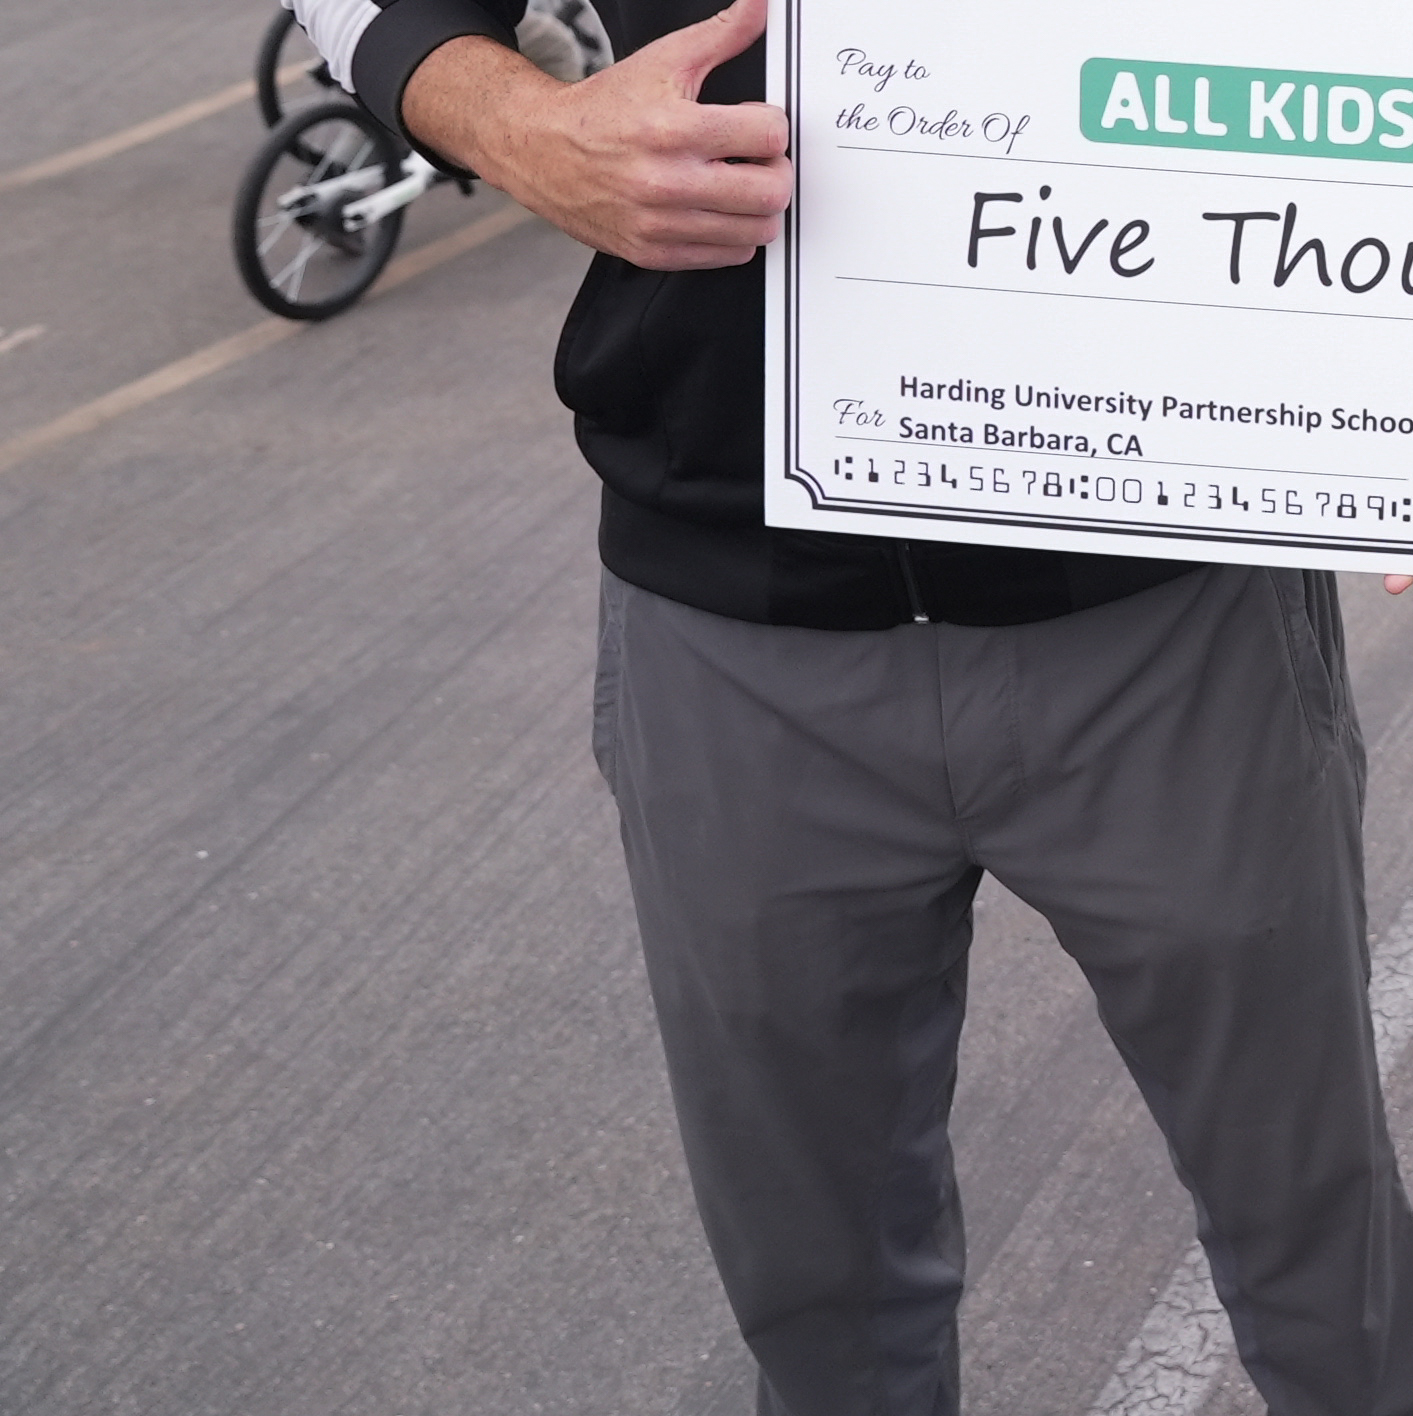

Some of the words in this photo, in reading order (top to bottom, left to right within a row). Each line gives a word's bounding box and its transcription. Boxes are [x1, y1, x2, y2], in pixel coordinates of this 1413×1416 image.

[837, 48, 896, 92] Pay
[903, 58, 930, 81] to
[836, 104, 878, 130] the
[888, 106, 970, 139] Order
[982, 113, 1030, 154] Of
[1102, 72, 1227, 136] ALL
[968, 185, 1154, 277] Five
[834, 399, 885, 428] For
[899, 417, 973, 446] Santa
[984, 424, 1098, 457] Barbara,
[1107, 434, 1143, 457] CA
[901, 376, 1005, 410] Harding
[1016, 385, 1152, 421] University
[1163, 396, 1321, 433] Partnership
